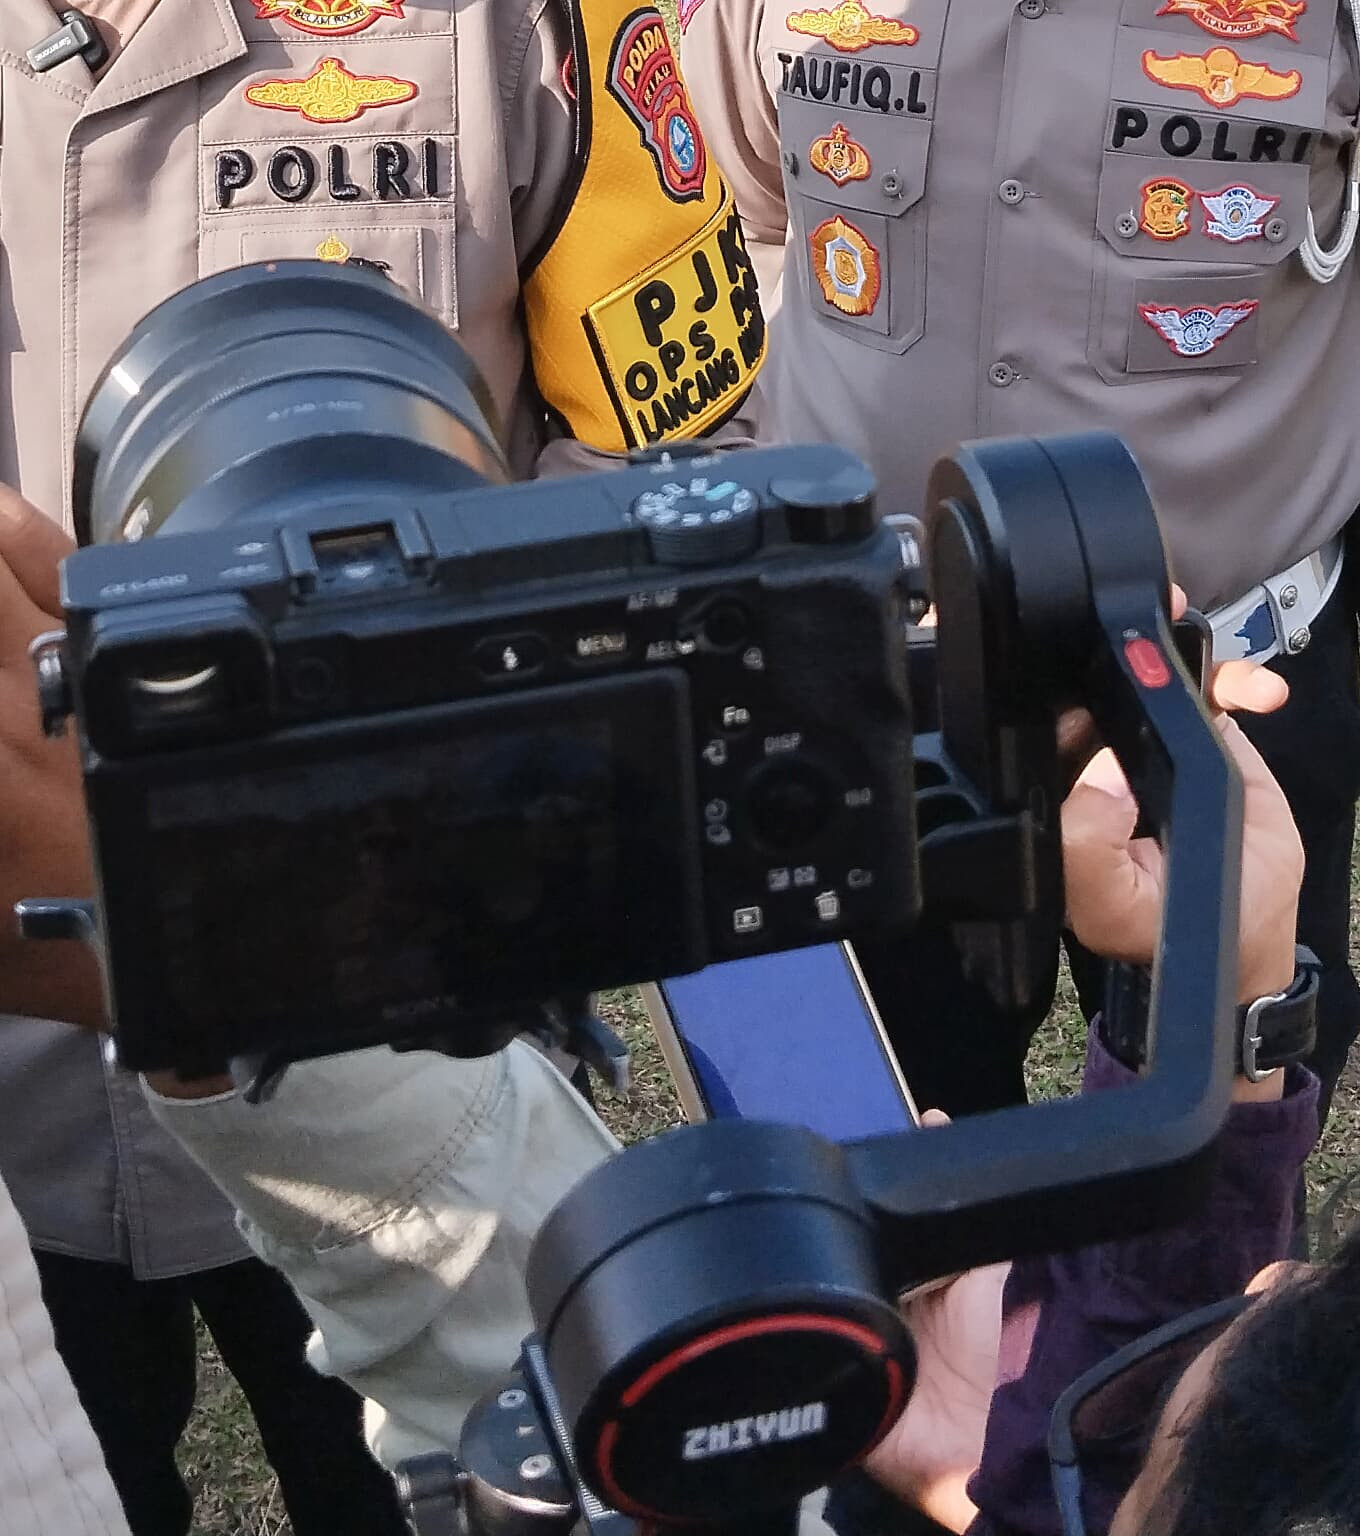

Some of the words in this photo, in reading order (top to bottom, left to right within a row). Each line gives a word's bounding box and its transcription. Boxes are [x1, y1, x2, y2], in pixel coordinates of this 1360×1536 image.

[623, 25, 666, 90] POLDA
[777, 52, 927, 114] TAUFIQ.L
[1111, 107, 1312, 163] POLRI
[214, 137, 438, 209] POLRI
[625, 319, 717, 402] OPS
[636, 347, 740, 443] LANCANG
[577, 633, 627, 656] MENU
[683, 1401, 826, 1462] ZHIYUN
